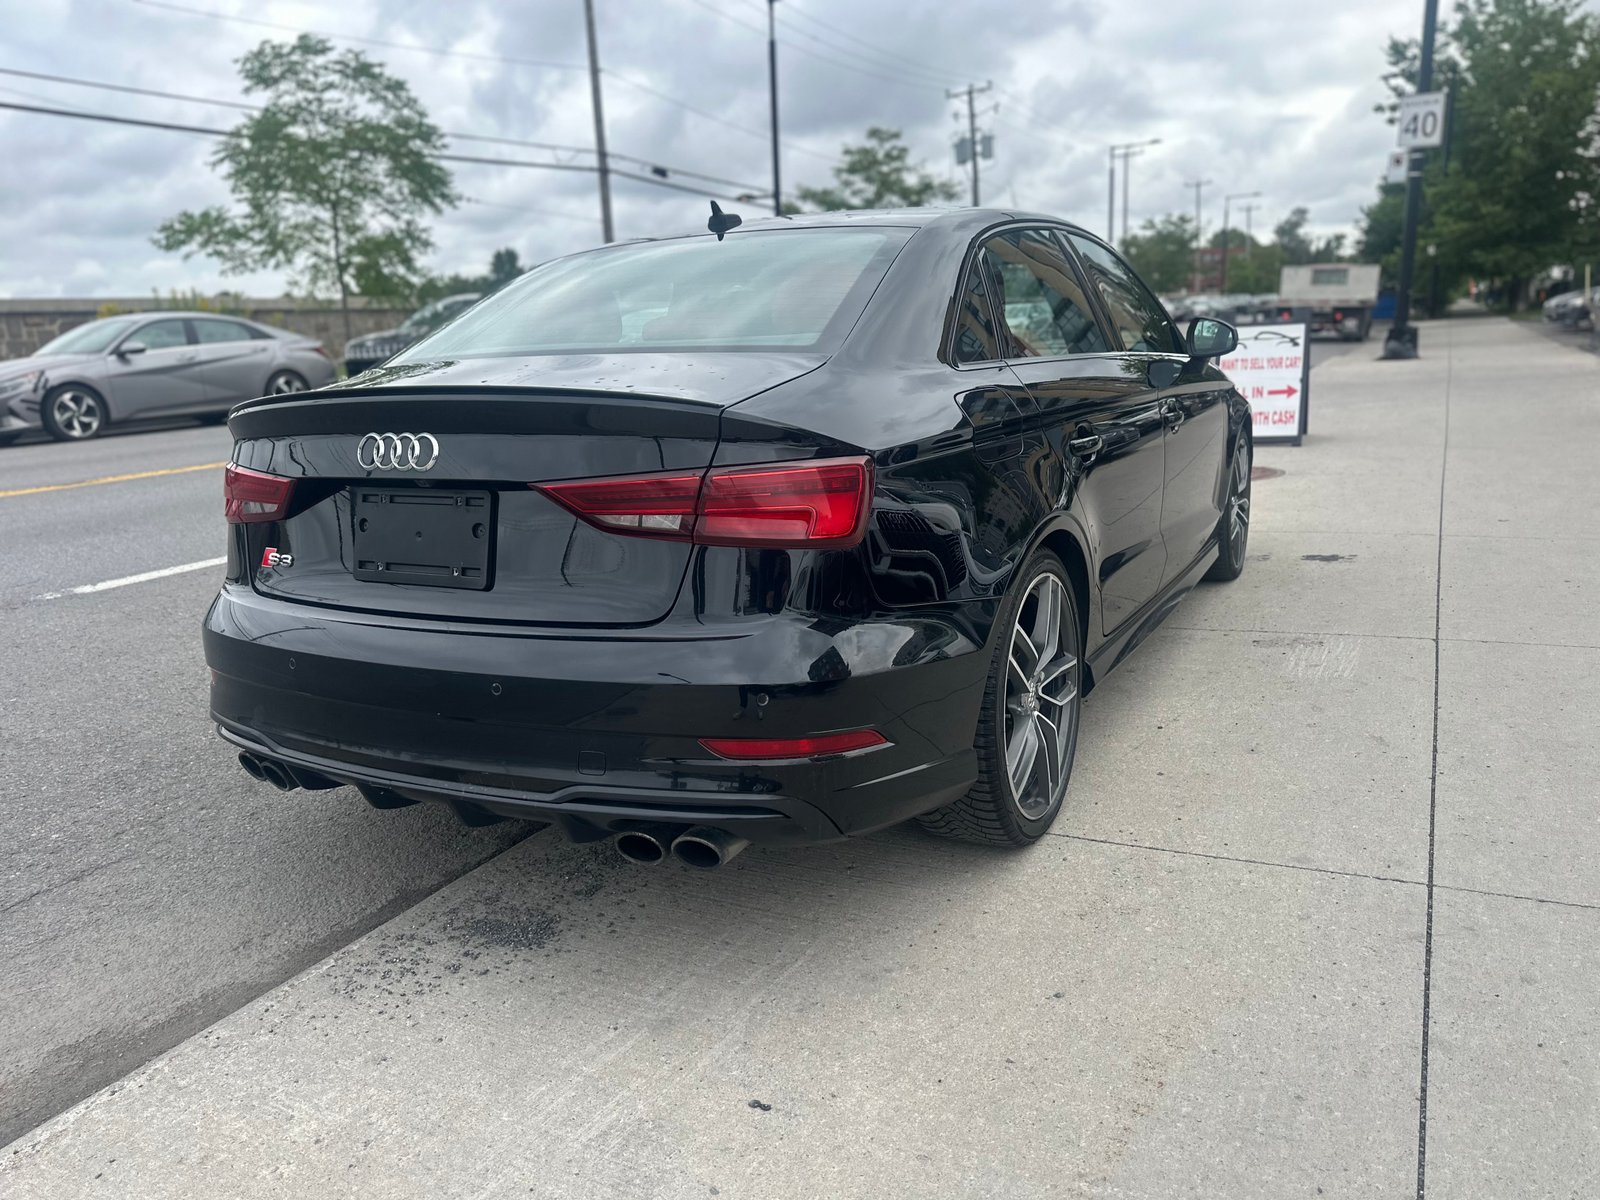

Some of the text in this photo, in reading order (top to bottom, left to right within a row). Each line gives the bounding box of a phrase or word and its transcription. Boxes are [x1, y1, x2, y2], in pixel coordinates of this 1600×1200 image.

[1404, 111, 1437, 138] 40
[1222, 358, 1239, 370] WANT
[1241, 358, 1248, 370] TO
[1250, 357, 1264, 369] SELL
[1267, 357, 1283, 369] YOUR
[1252, 386, 1264, 398] IN
[1253, 410, 1295, 425] ITH CASH
[267, 552, 293, 568] S3
